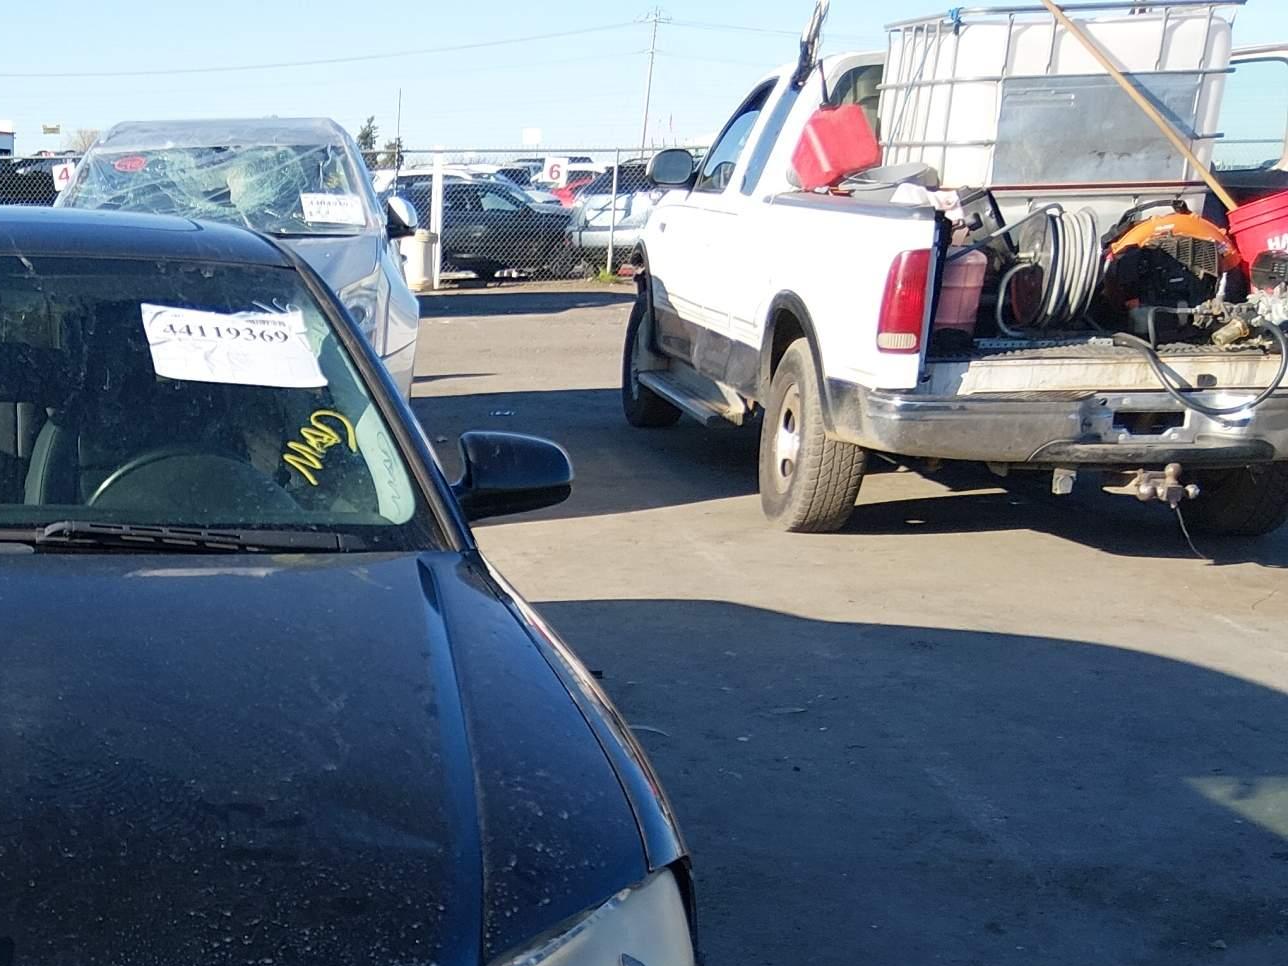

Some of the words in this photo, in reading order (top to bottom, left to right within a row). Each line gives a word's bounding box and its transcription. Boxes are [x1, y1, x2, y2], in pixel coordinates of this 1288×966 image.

[58, 167, 70, 184] 4
[549, 164, 561, 180] 6
[162, 323, 289, 343] 44119369
